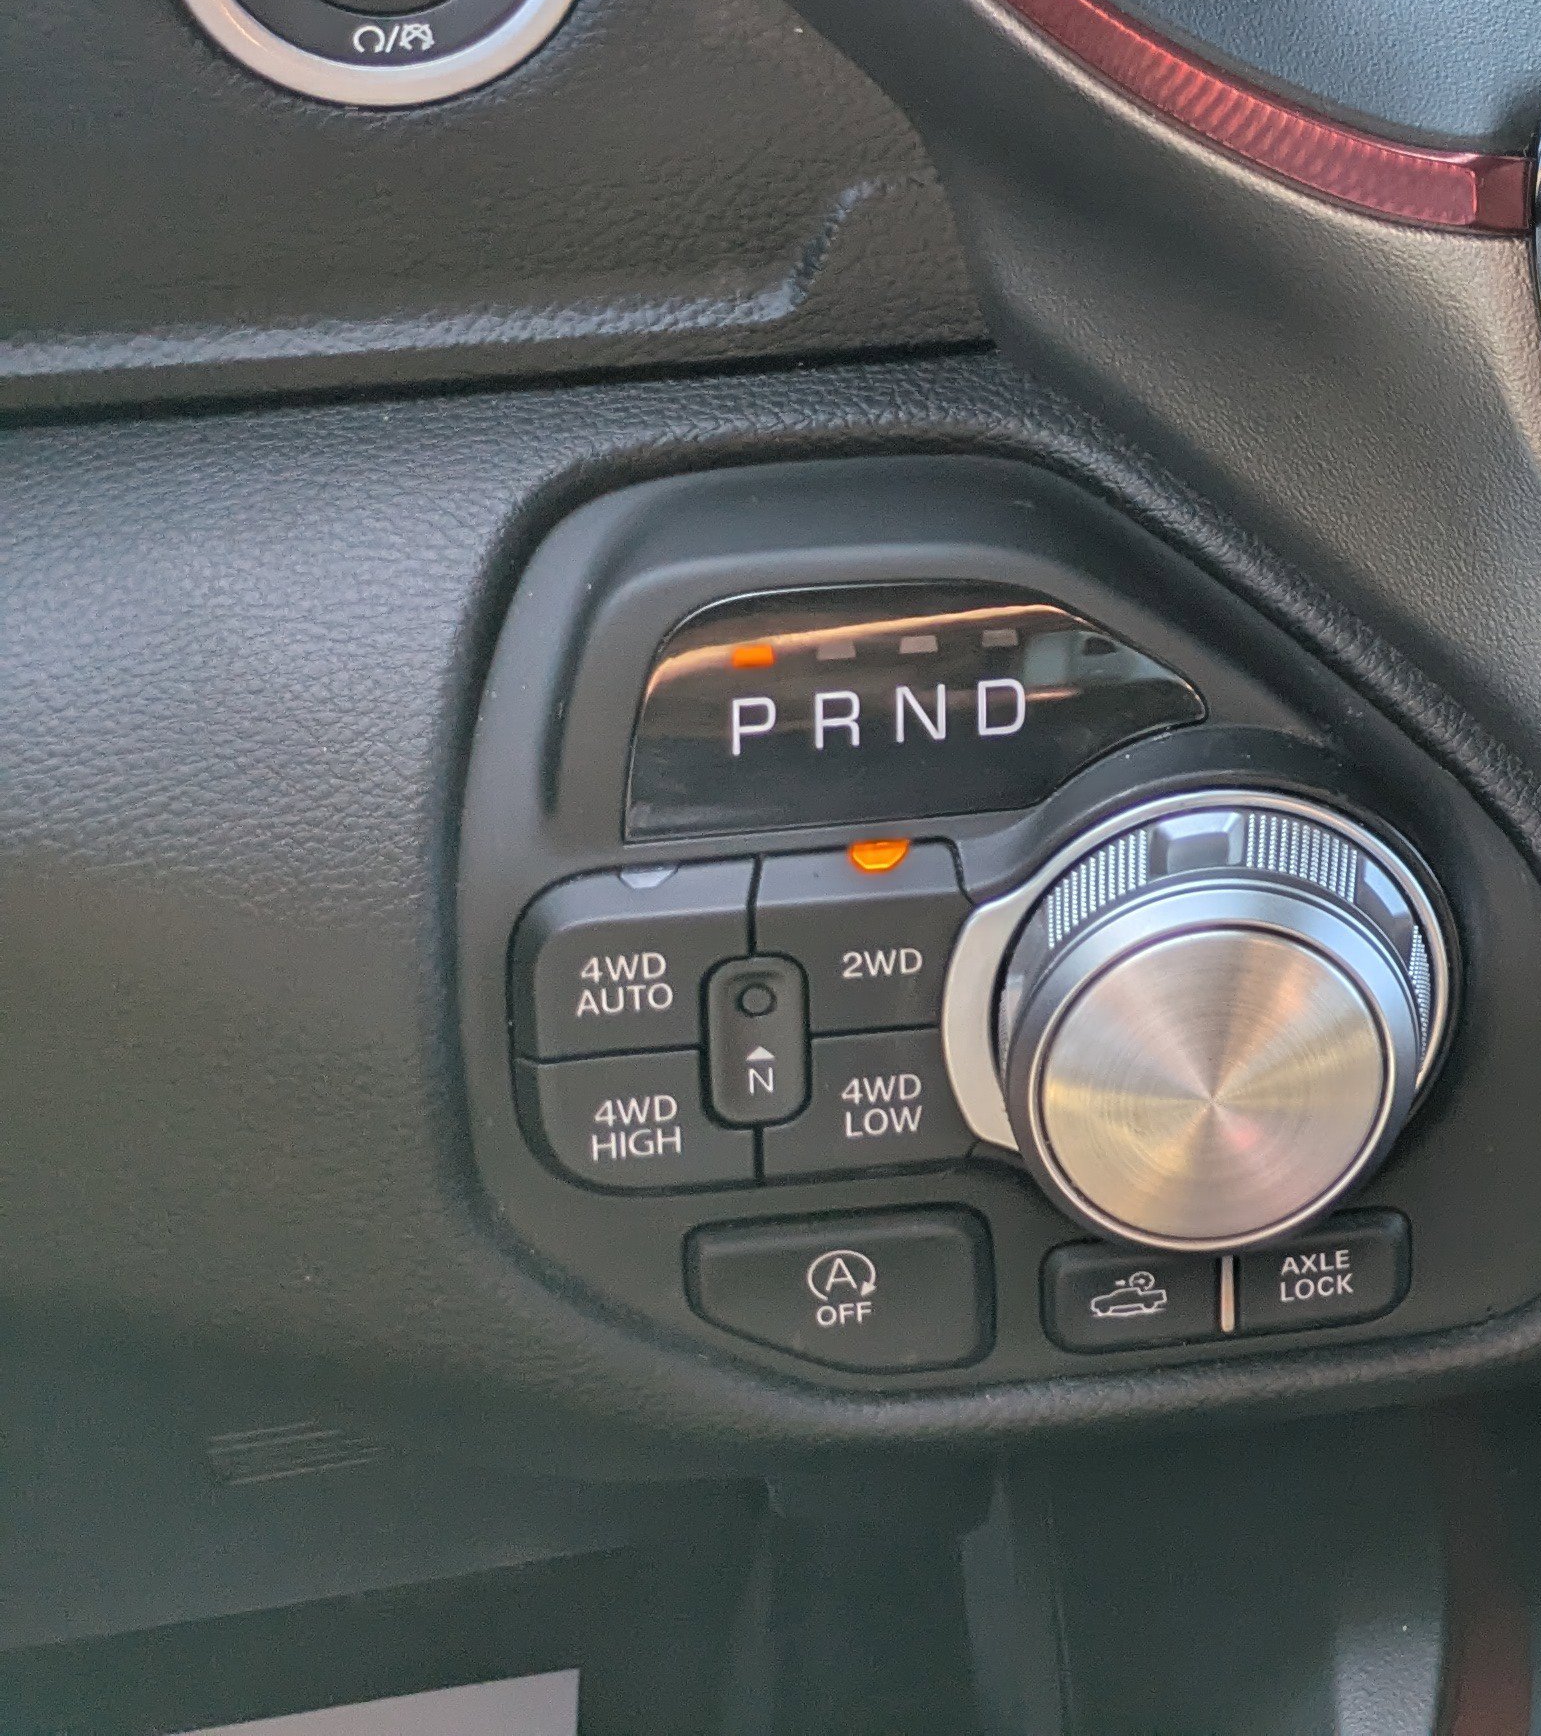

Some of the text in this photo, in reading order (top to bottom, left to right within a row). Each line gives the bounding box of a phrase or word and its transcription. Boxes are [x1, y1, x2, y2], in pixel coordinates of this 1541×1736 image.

[581, 952, 667, 984] 4WD
[841, 946, 923, 979] 2WD
[576, 982, 673, 1018] AUTO
[747, 1065, 775, 1096] N
[841, 1074, 923, 1104] 4WD
[594, 1095, 678, 1129] 4WD
[844, 1104, 923, 1139] LOW
[591, 1124, 682, 1162] HIGH
[1280, 1249, 1351, 1276] AXLE
[1280, 1271, 1353, 1304] LOCK
[816, 1301, 872, 1328] OFF
